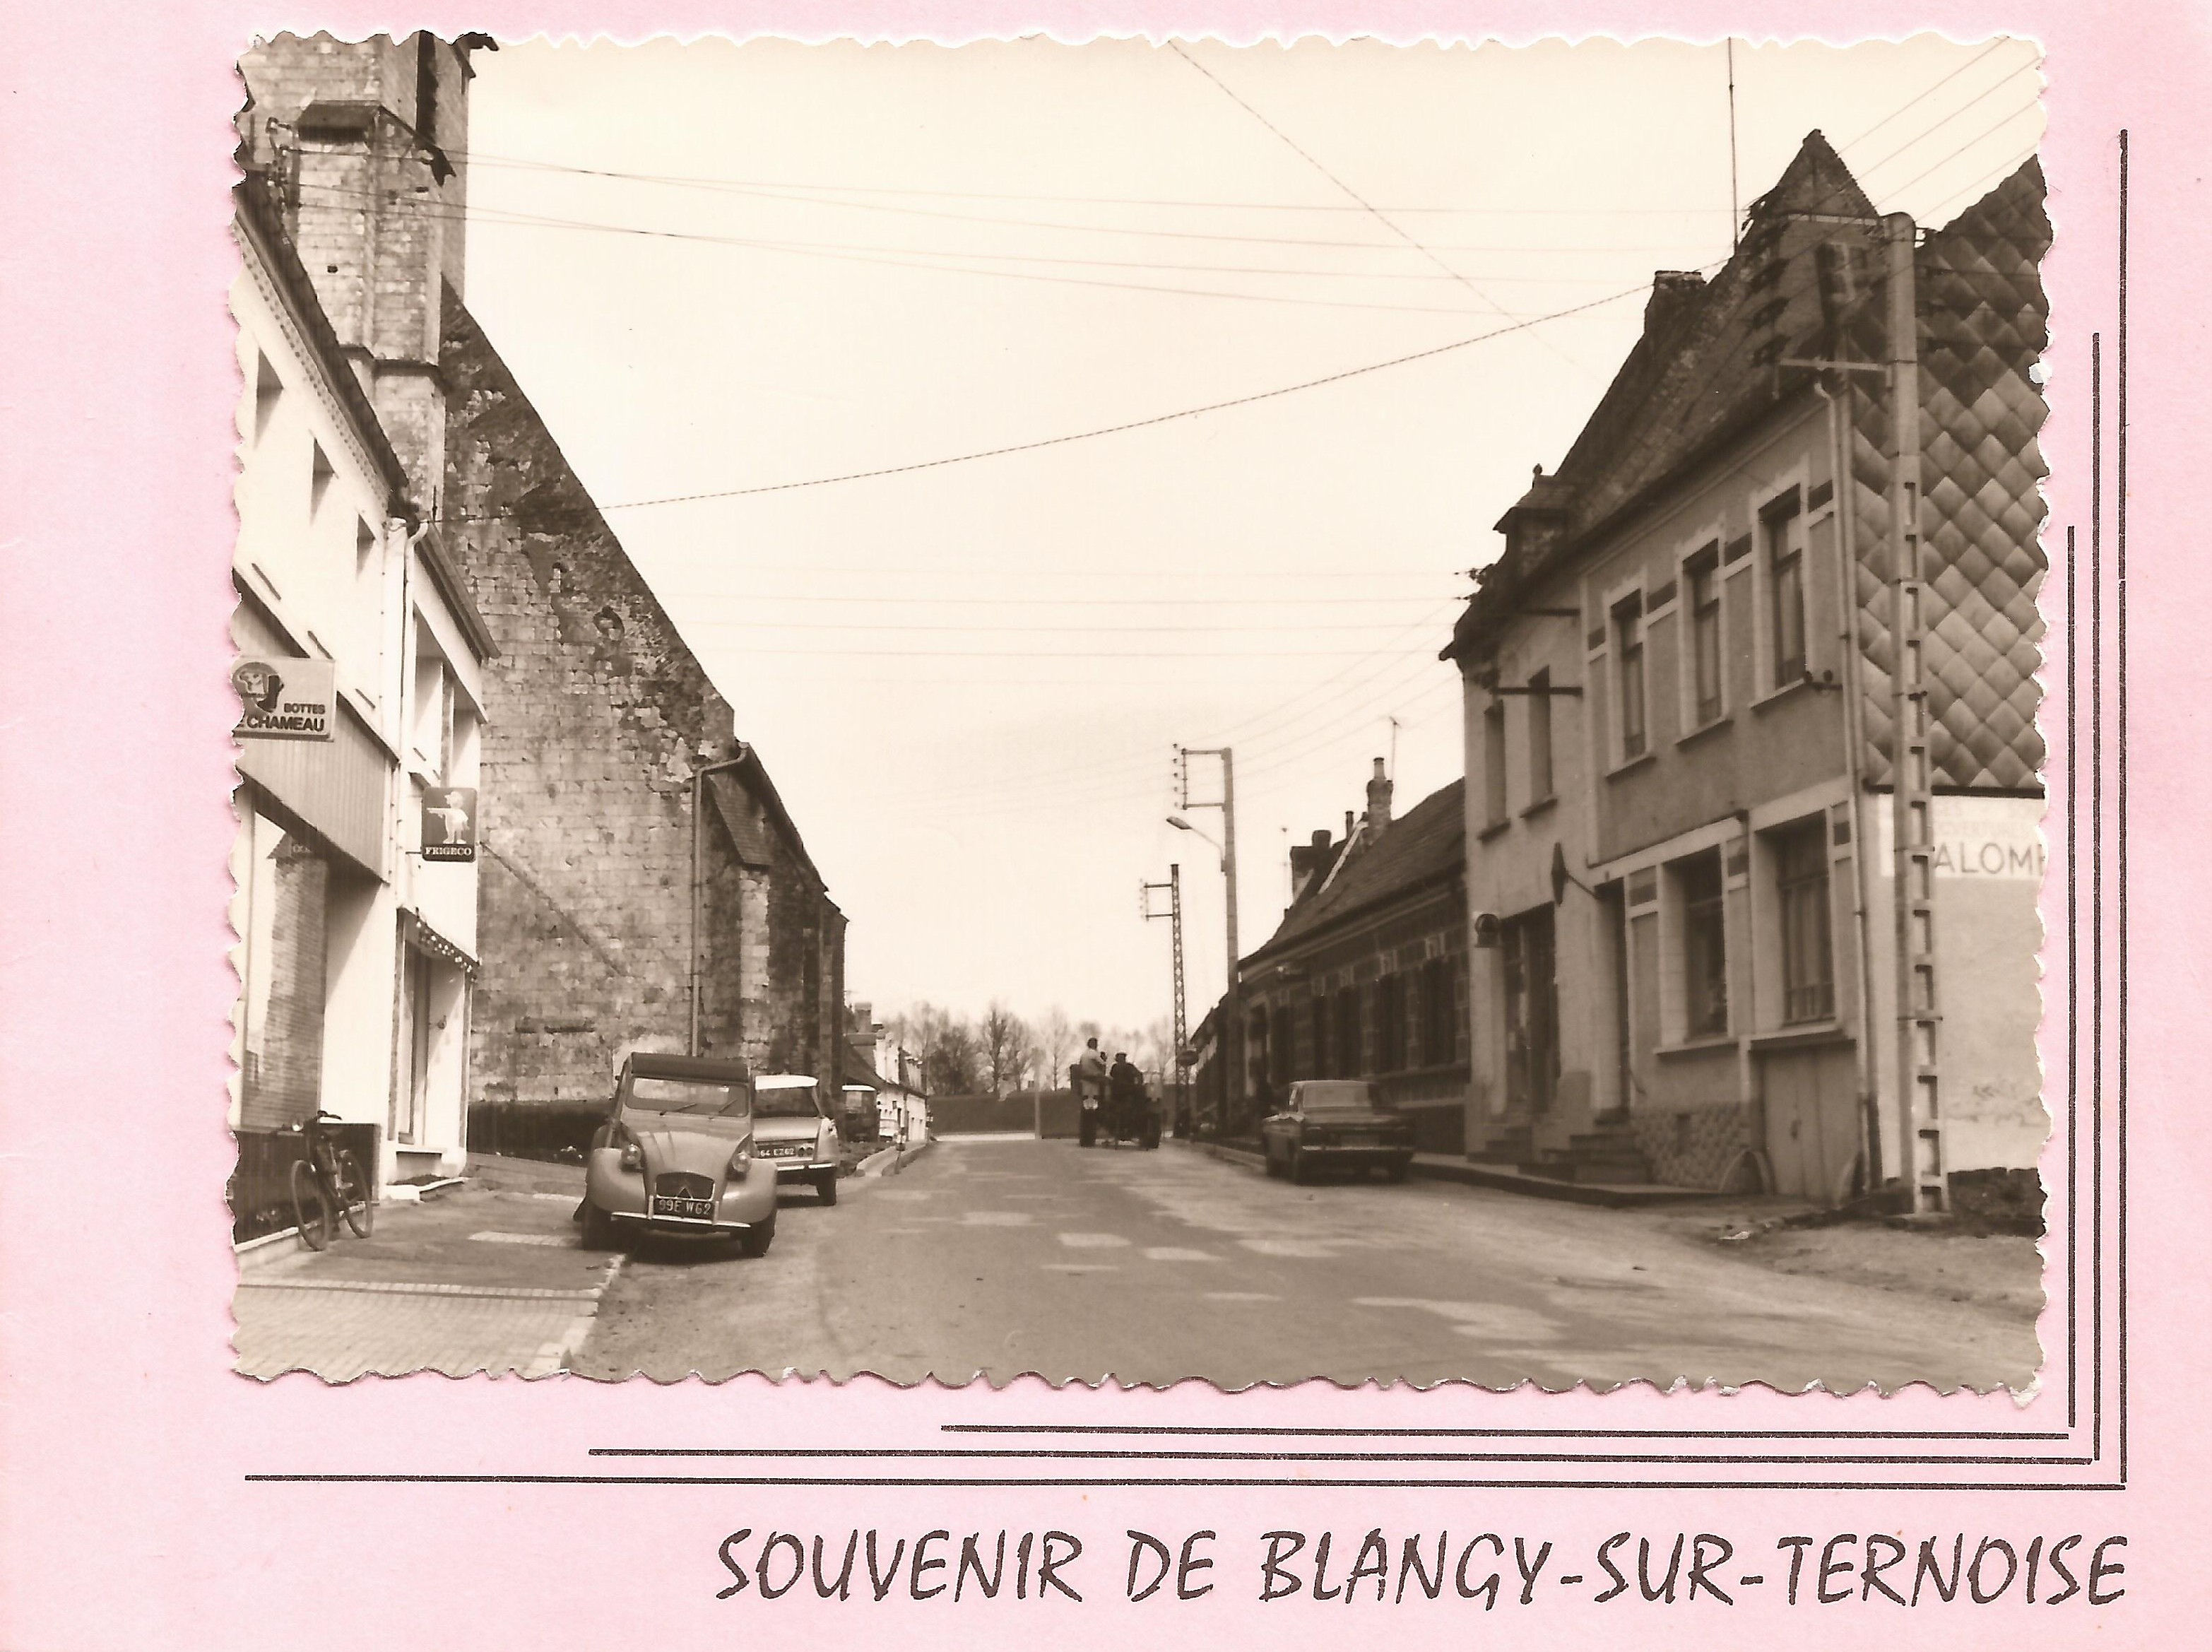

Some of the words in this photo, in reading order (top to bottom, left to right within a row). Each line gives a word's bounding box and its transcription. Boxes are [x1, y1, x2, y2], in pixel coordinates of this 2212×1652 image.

[283, 703, 326, 714] BOTTES
[247, 715, 325, 731] CHAMEAU
[425, 846, 472, 856] FRIGECO
